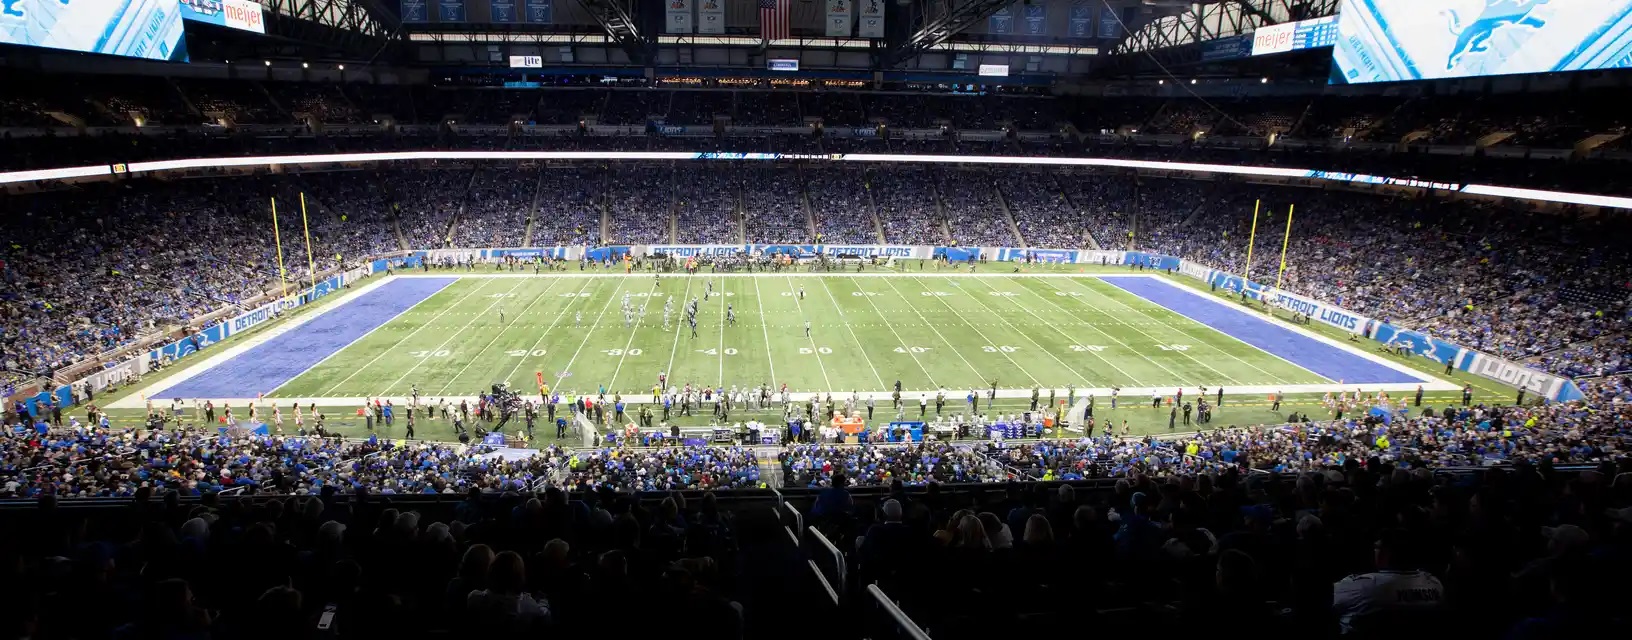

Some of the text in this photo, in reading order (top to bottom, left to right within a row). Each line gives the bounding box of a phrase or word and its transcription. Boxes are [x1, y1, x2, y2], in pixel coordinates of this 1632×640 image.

[225, 4, 260, 27] meijer
[1255, 29, 1291, 48] meijer
[524, 56, 540, 67] Lite
[654, 247, 739, 257] DETROIT LIONS
[828, 247, 911, 257] DETROIT LIONS
[235, 308, 270, 331] DETROIT
[1320, 308, 1359, 330] LIONS
[703, 348, 738, 356] 40
[799, 347, 833, 355] 50
[893, 346, 925, 354] 40
[981, 345, 1016, 353] 30
[1482, 359, 1547, 394] LIONS
